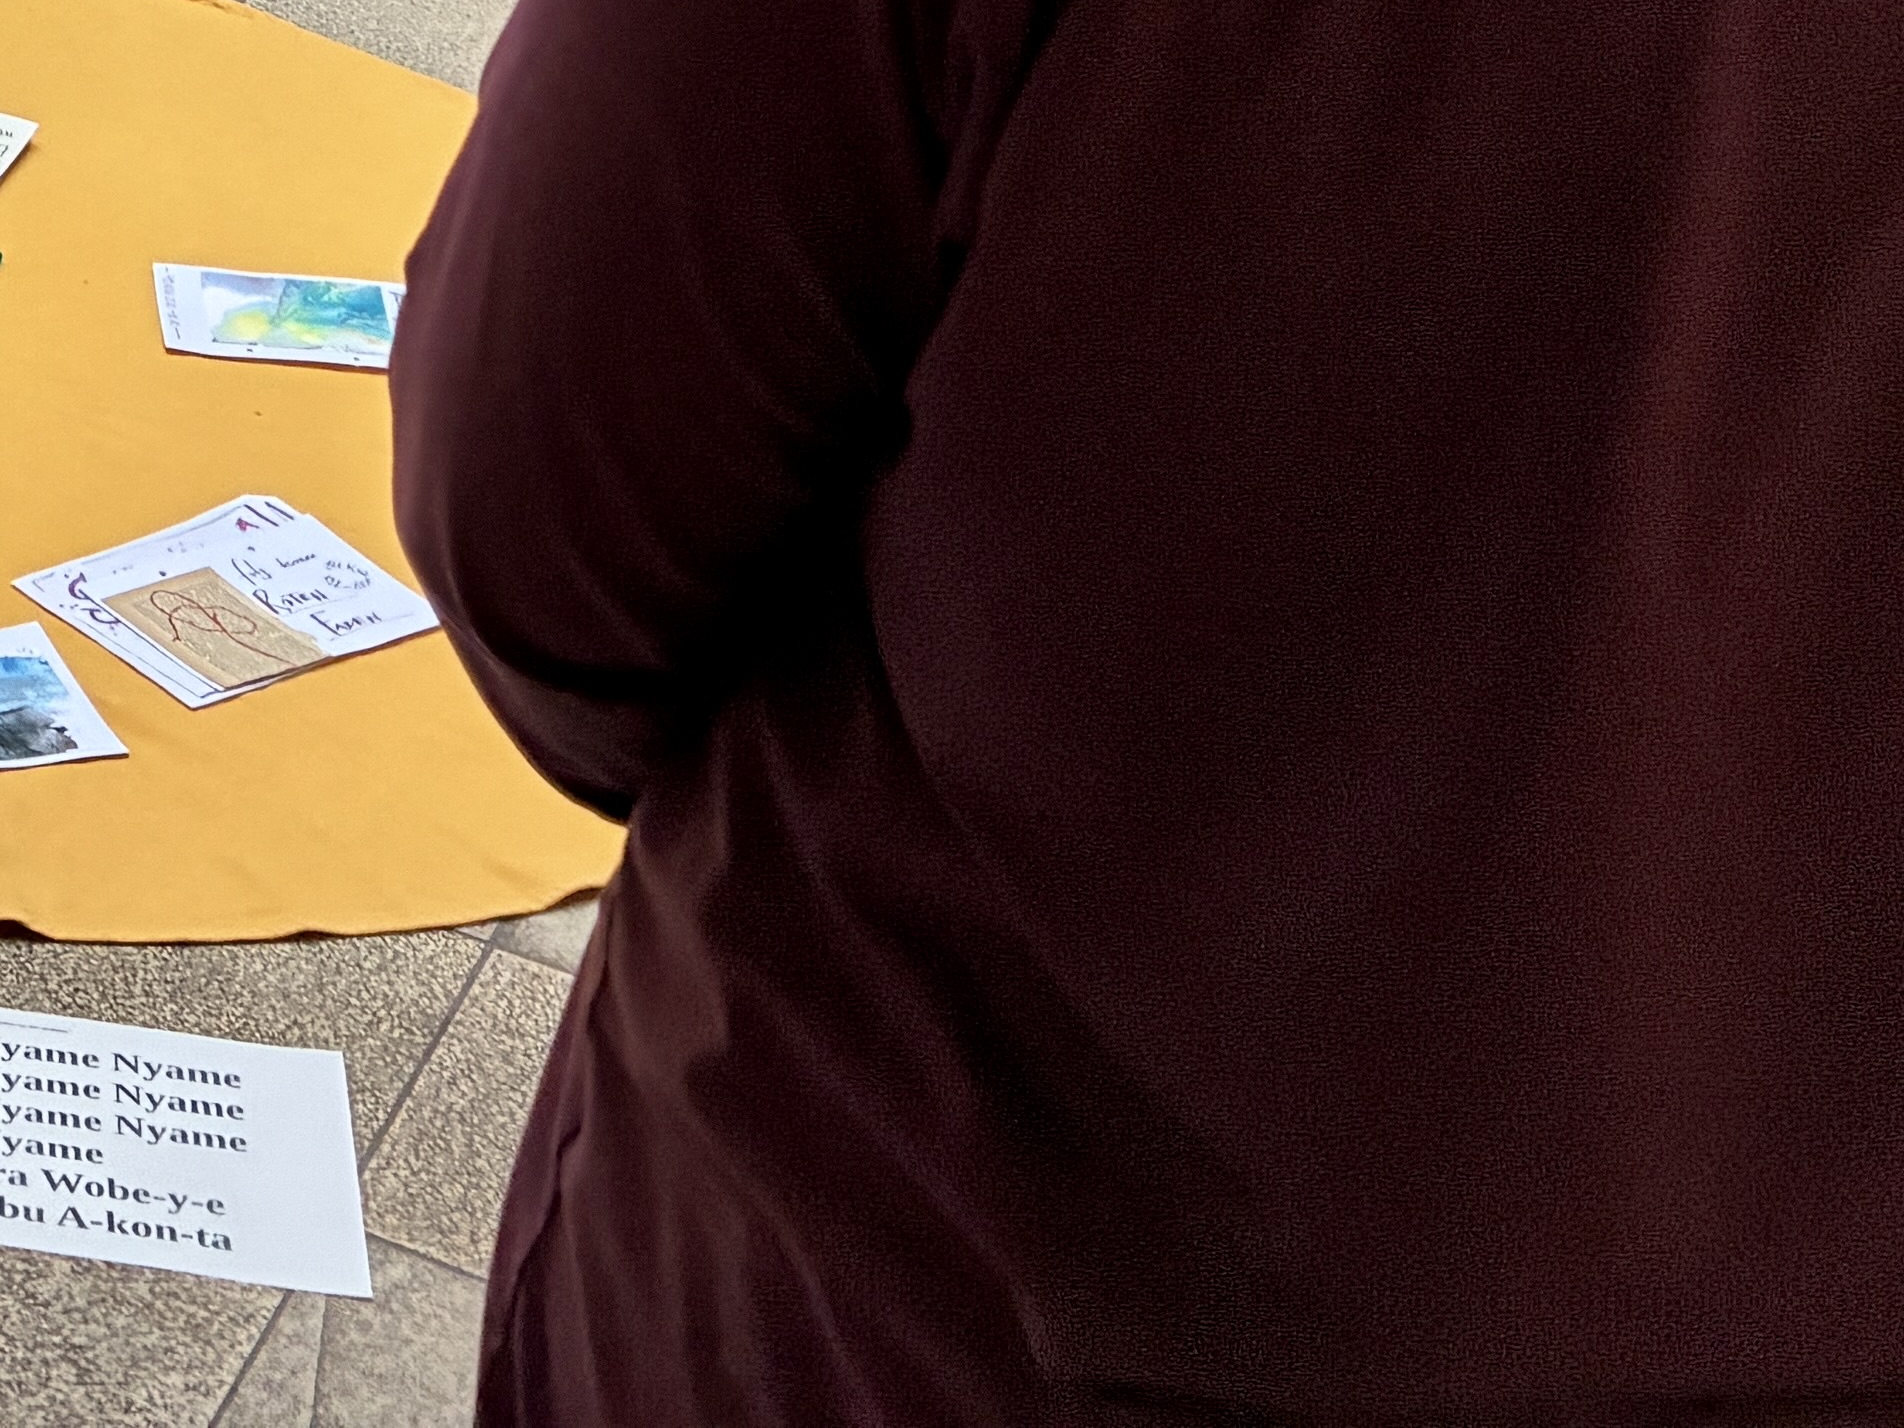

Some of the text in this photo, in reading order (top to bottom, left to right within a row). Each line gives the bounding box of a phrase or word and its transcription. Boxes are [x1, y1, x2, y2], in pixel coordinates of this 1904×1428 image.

[112, 1052, 241, 1089] Nyame
[114, 1083, 244, 1121] Nyame
[114, 1114, 247, 1153] Nyame
[40, 1168, 226, 1216] Wobe-y-e
[56, 1205, 233, 1252] A-kon-ta
